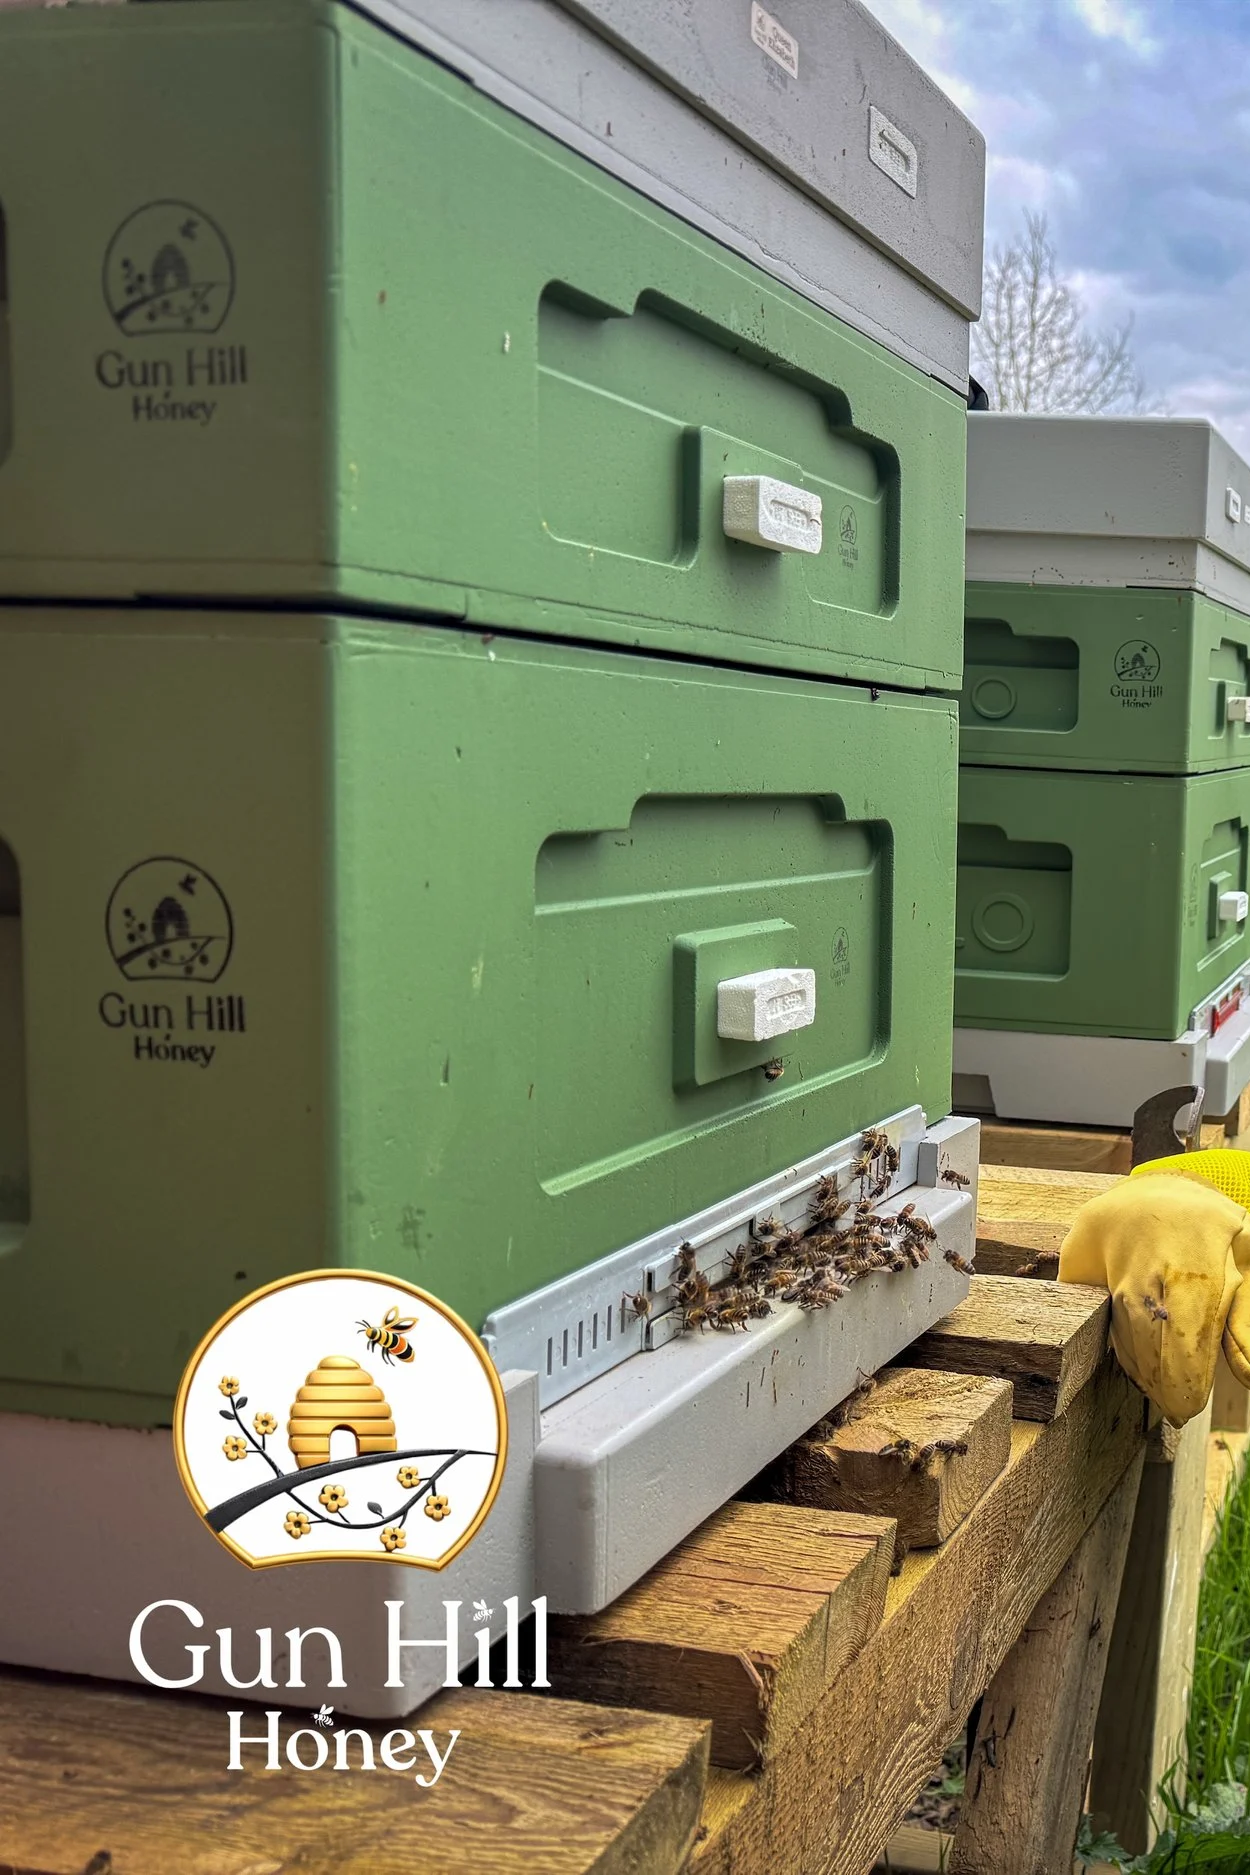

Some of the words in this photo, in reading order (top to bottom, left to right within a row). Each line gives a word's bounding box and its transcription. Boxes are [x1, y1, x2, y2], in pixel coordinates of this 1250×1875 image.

[95, 349, 173, 389] Gun
[186, 343, 248, 387] Hill
[132, 393, 217, 428] Honey
[1110, 684, 1138, 698] Gun
[1141, 685, 1163, 698] Hill
[98, 991, 174, 1029] Gun
[185, 994, 246, 1033] Hill
[133, 1034, 216, 1070] Honey
